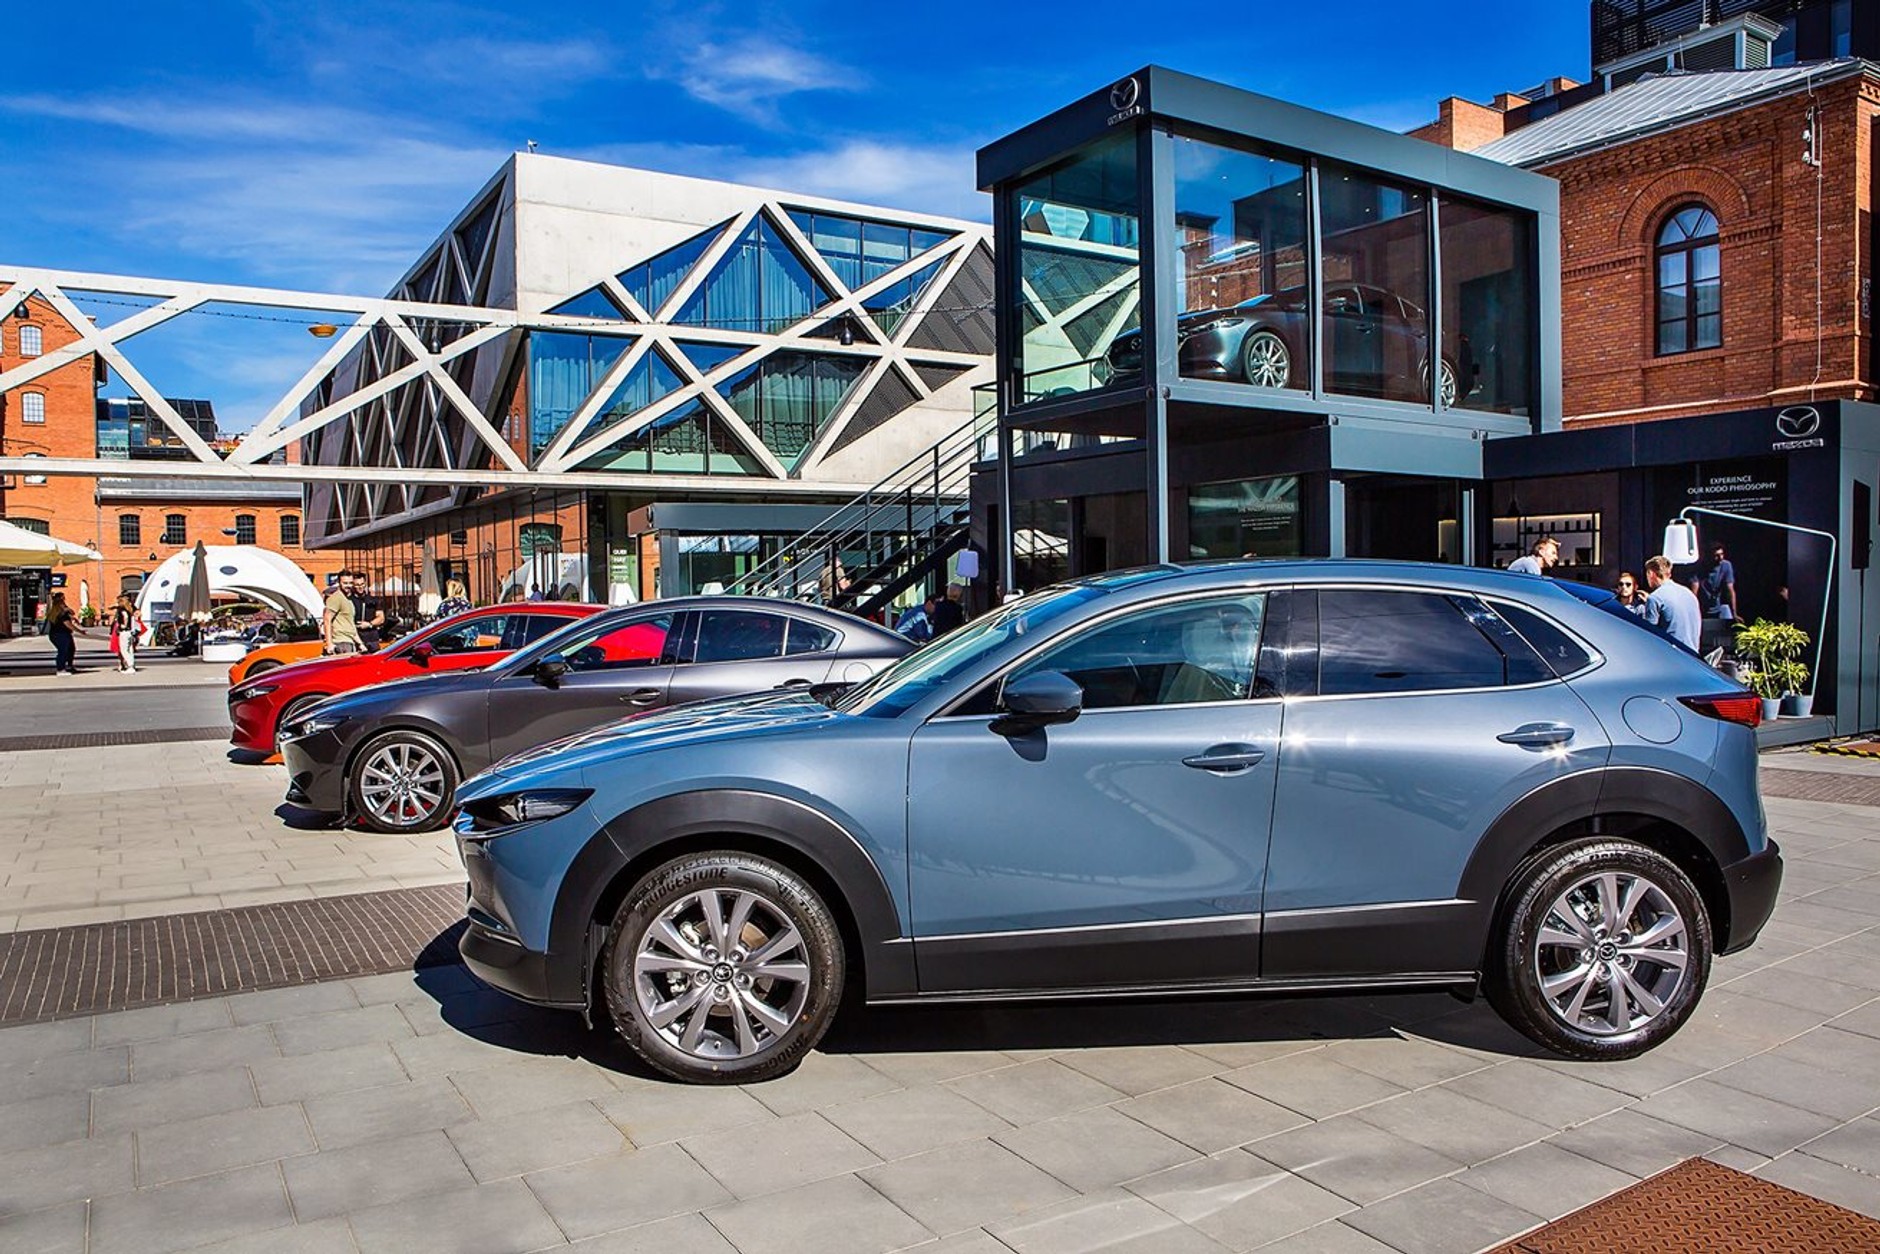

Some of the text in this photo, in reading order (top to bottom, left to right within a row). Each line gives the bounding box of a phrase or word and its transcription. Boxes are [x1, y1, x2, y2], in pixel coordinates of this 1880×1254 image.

[1710, 475, 1752, 485] EXPERIENCE
[1687, 483, 1777, 495] OUR KODO PHILOSOPHY
[639, 866, 729, 916] BRIDGESTONE
